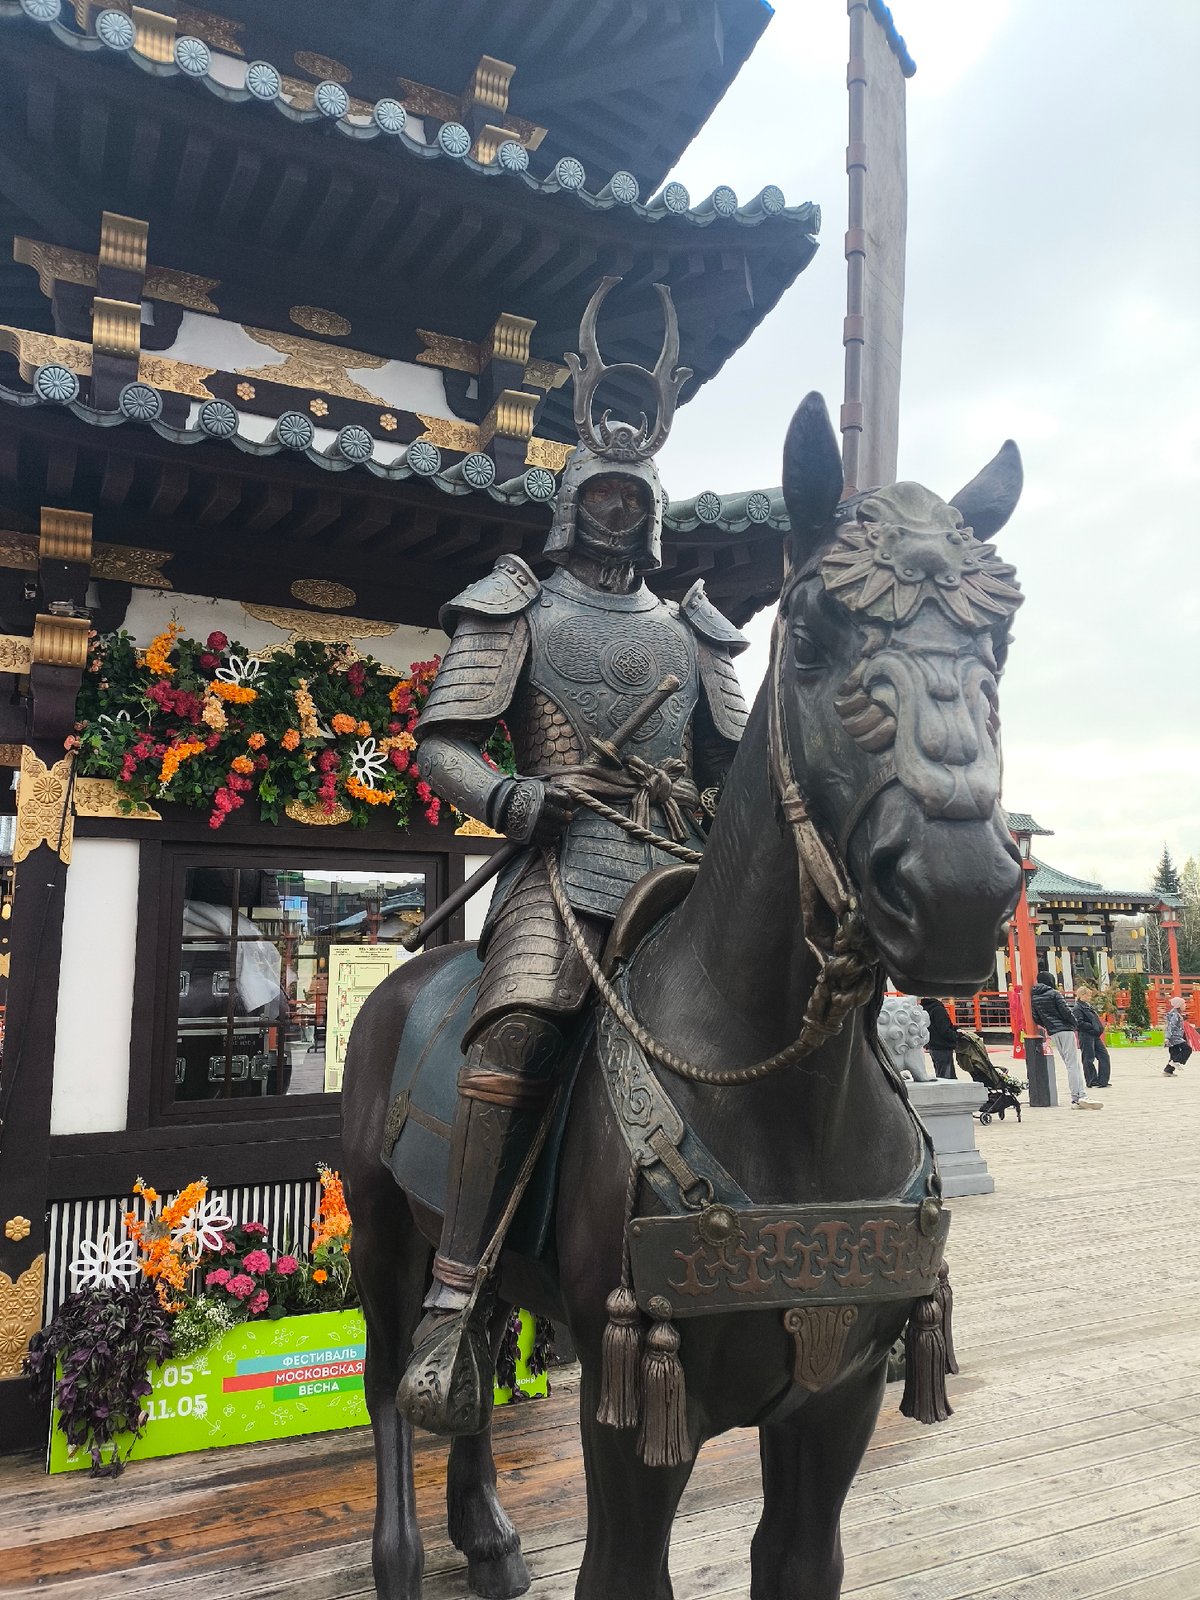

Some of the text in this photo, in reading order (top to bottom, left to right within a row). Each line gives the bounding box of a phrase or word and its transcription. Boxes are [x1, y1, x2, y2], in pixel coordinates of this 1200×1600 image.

[282, 1348, 357, 1367] ФЕСТИВАЛЬ
[275, 1362, 363, 1384] МОСКОВСКАЯ
[298, 1381, 340, 1396] ВЕСНА
[146, 1394, 208, 1421] 11.05
